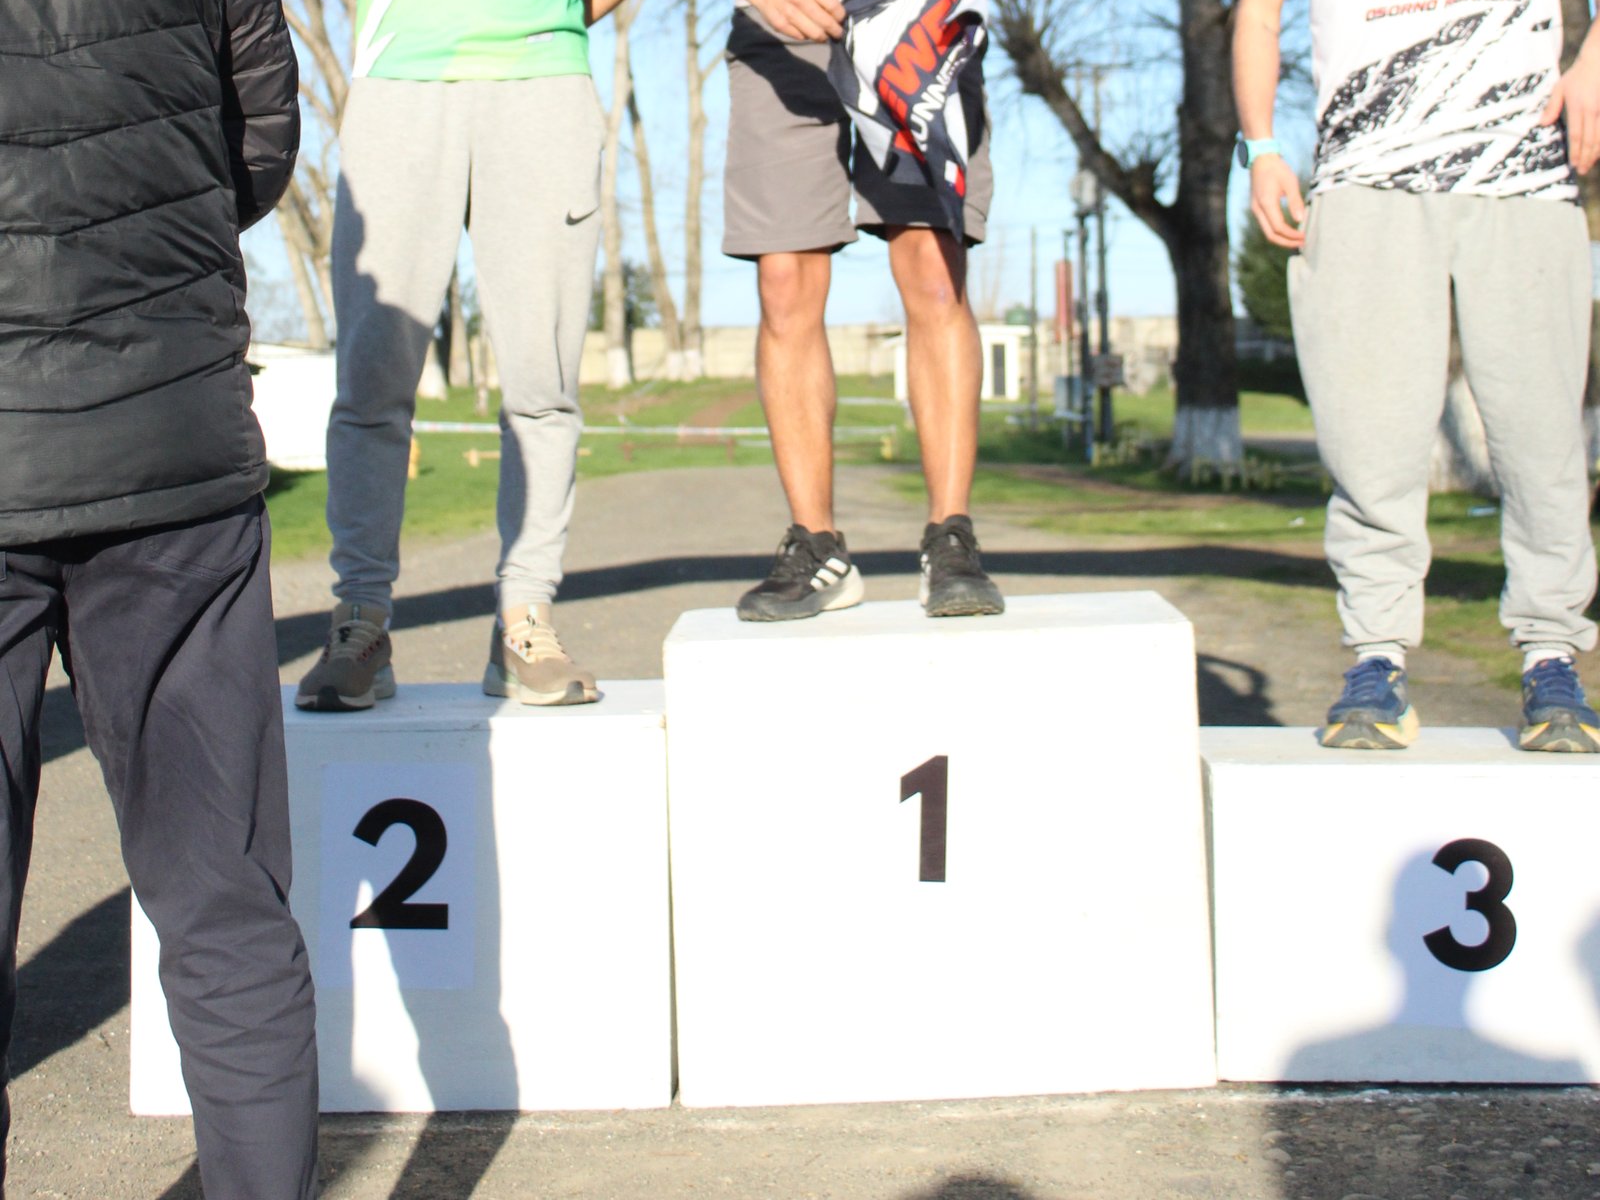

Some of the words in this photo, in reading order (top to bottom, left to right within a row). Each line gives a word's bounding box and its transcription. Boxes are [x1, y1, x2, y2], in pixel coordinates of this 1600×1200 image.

[350, 798, 449, 931] 2
[901, 756, 948, 882] 1
[1422, 838, 1517, 973] 3
